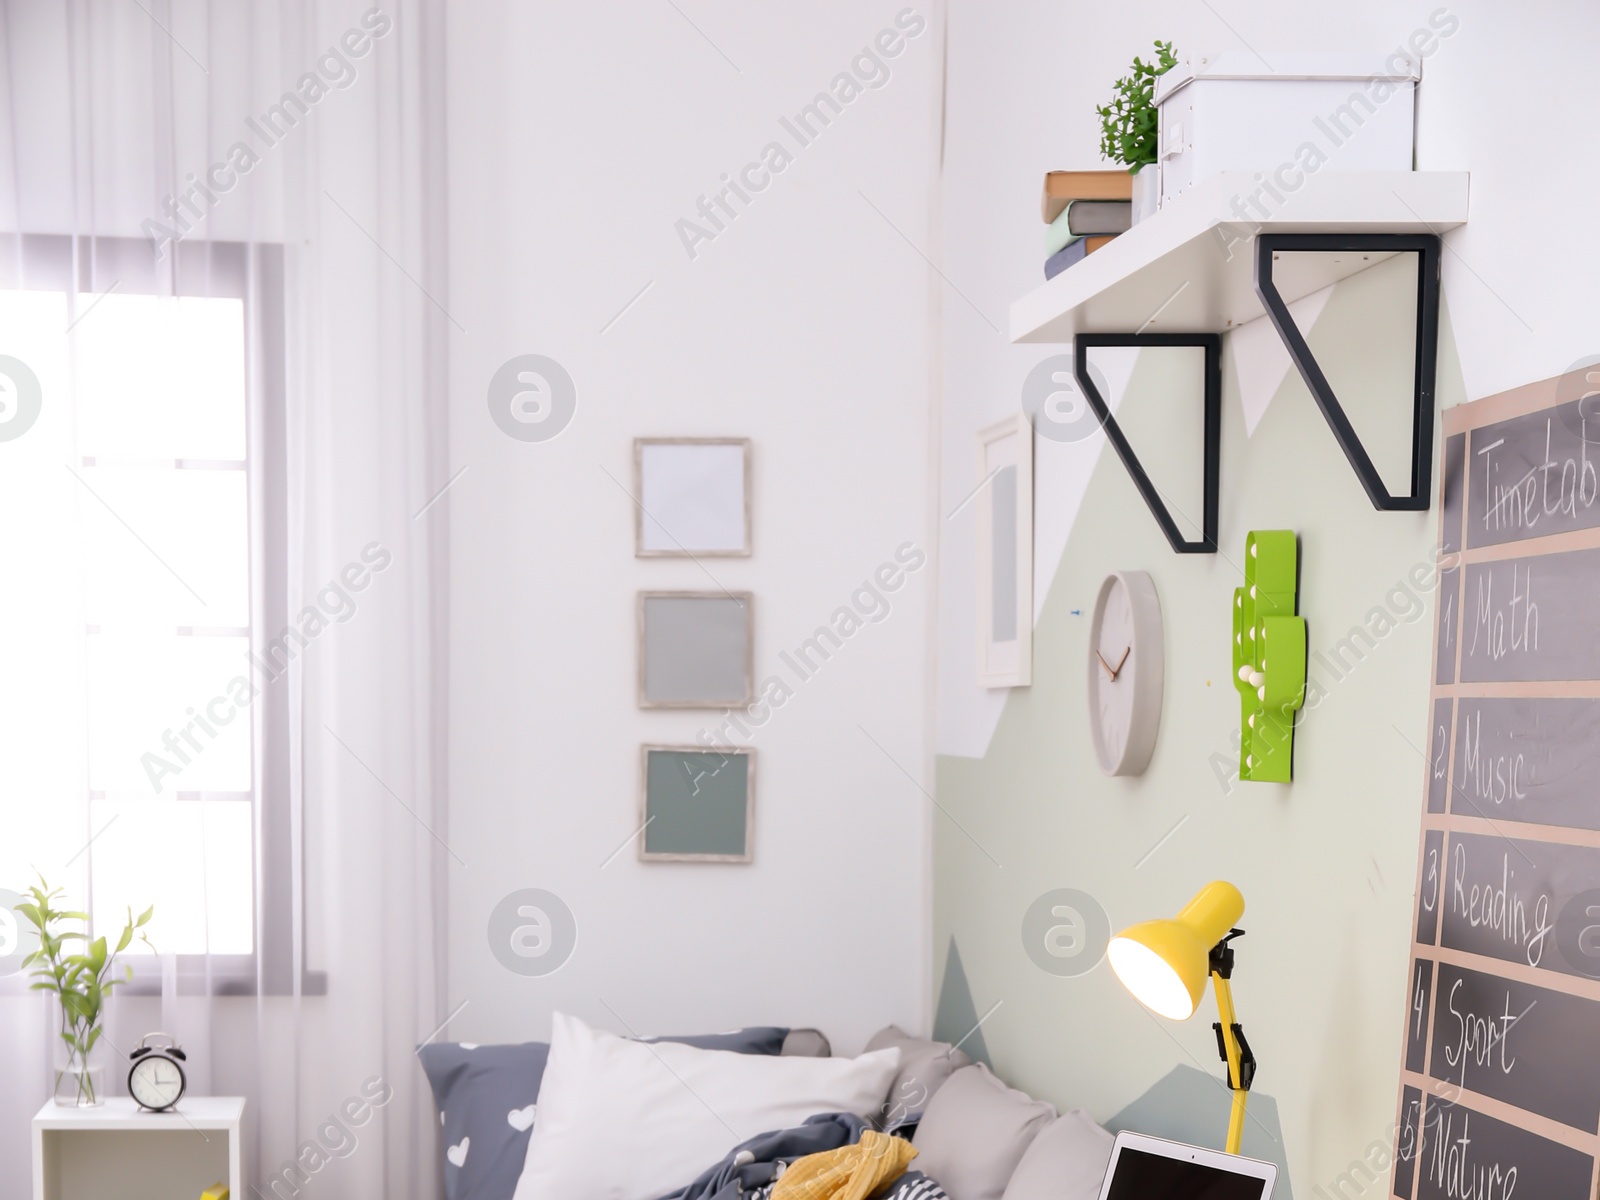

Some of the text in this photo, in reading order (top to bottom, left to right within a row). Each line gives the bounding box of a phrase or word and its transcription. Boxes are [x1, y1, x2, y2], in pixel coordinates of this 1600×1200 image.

[1470, 564, 1538, 661] Math
[1435, 710, 1527, 804] 2 Music
[1423, 849, 1437, 911] 3
[1453, 843, 1553, 967] Reading
[1414, 966, 1517, 1091] 4 Sport
[1400, 1101, 1418, 1161] 5
